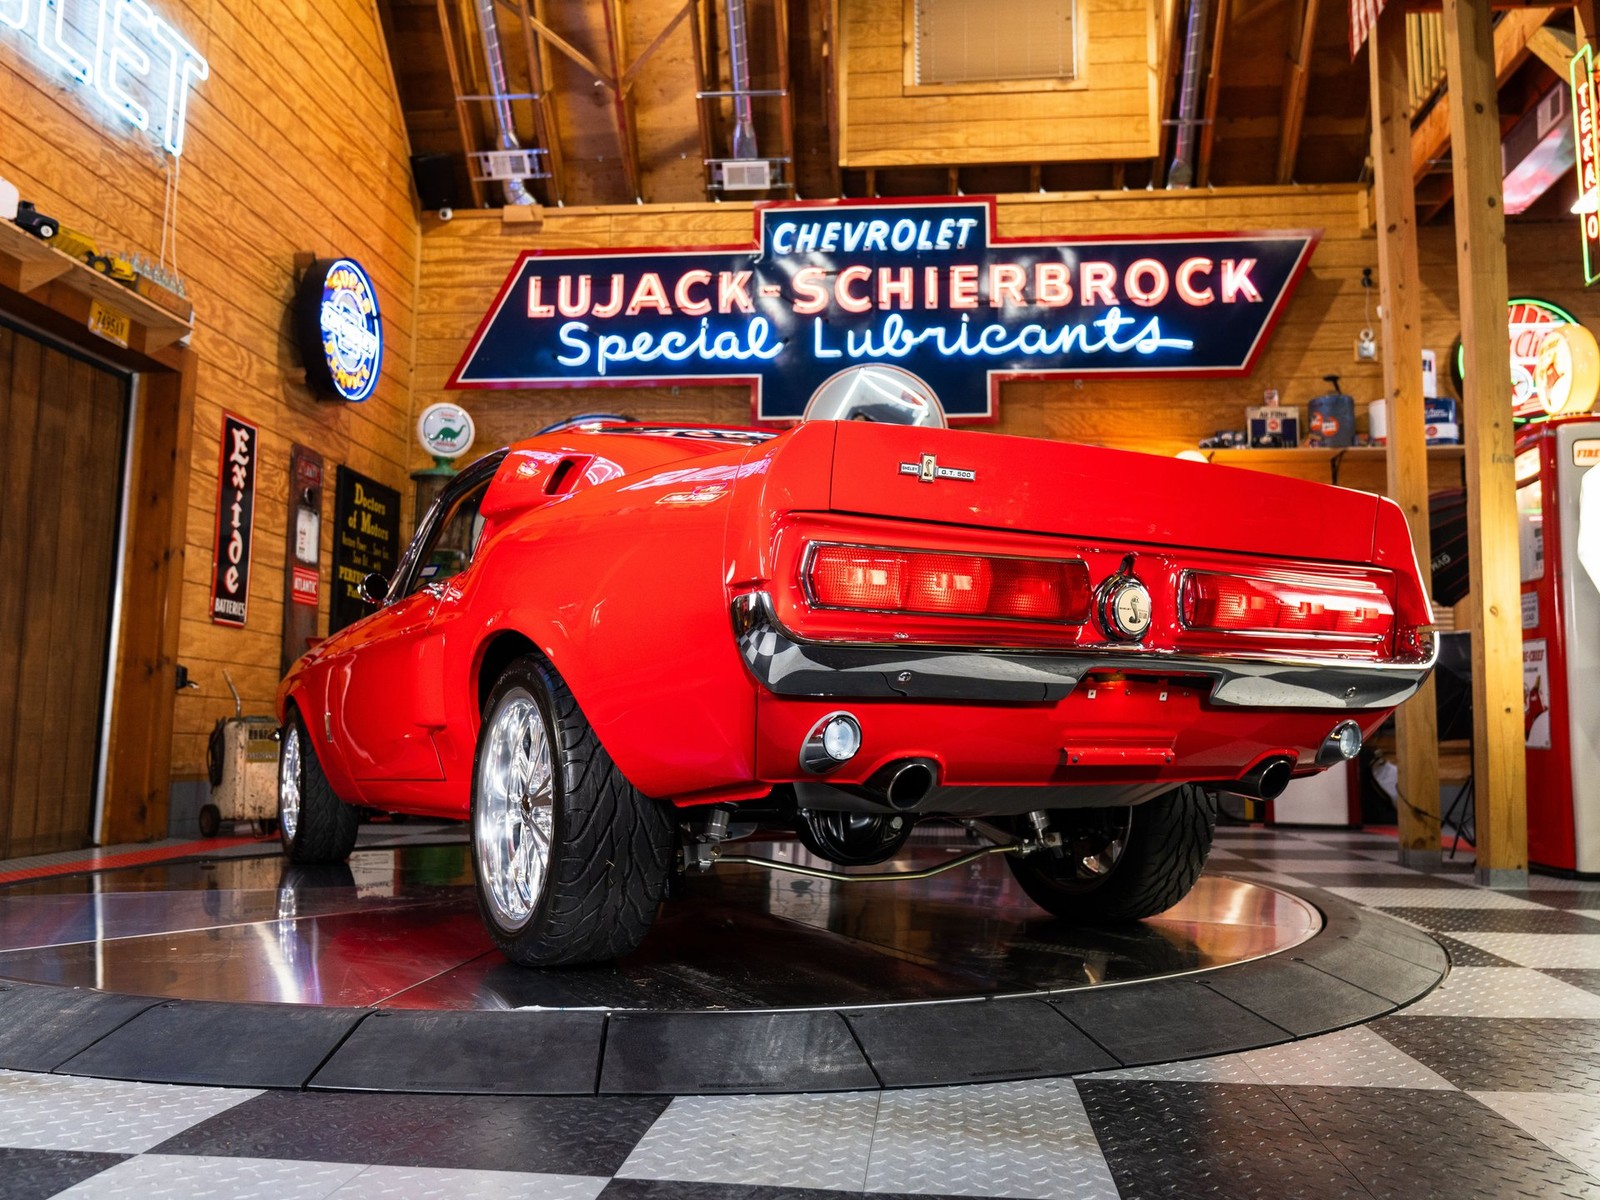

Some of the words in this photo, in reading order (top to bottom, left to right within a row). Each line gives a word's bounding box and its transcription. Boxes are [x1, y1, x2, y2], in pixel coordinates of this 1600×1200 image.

[0, 0, 210, 158] LET
[1577, 82, 1600, 240] TEXAO
[772, 217, 978, 254] CHEVROLET
[554, 317, 786, 375] Special
[814, 306, 1194, 358] Lubricants
[957, 470, 972, 478] 500
[224, 427, 250, 594] Exide
[354, 483, 386, 515] Doctors
[348, 510, 358, 529] of
[361, 511, 389, 541] Motors
[293, 577, 318, 595] ATLANTIC
[338, 565, 367, 583] PERFE
[214, 597, 246, 616] BATTERIES
[1523, 650, 1544, 663] E-CHIEF
